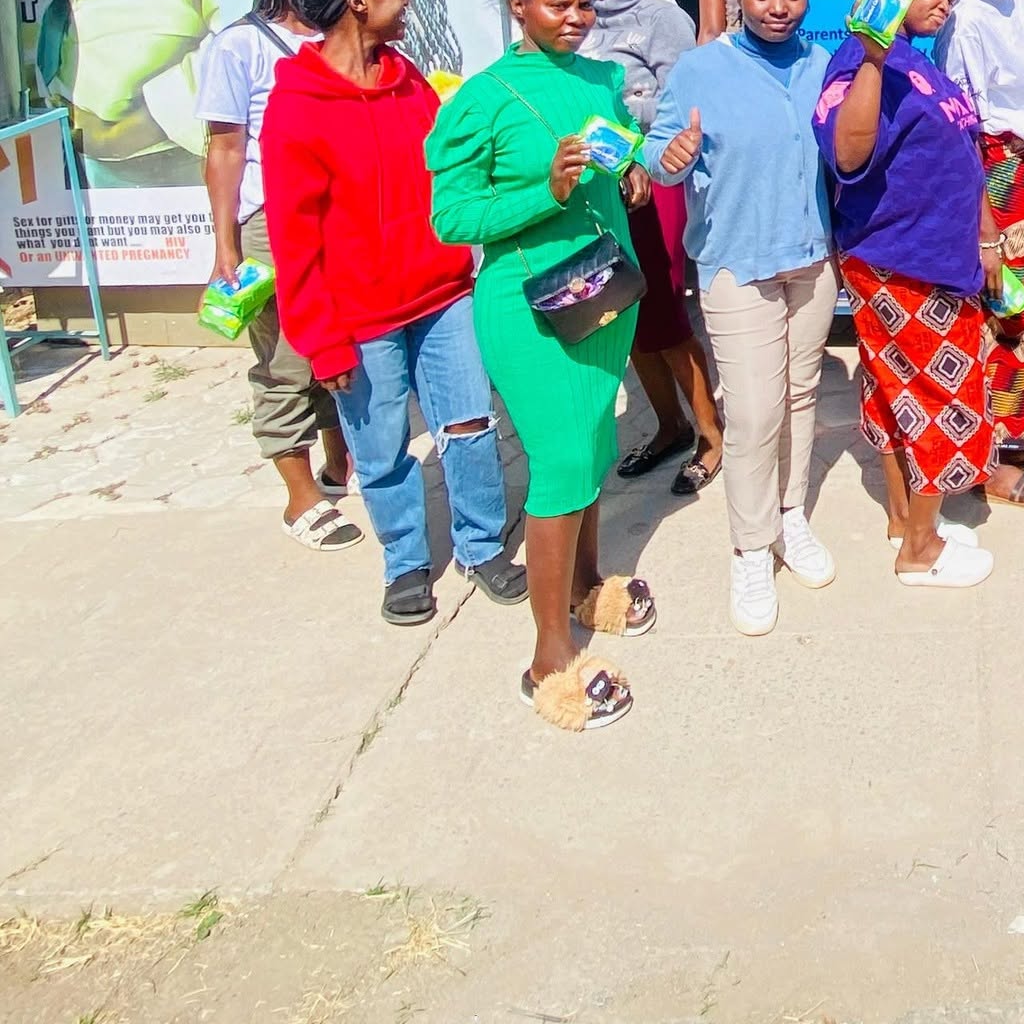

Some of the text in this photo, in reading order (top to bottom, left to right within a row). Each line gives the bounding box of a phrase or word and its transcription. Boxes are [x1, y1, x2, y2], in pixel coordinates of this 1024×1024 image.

[799, 29, 850, 42] Parents
[13, 216, 34, 227] Sex
[85, 214, 95, 225] or
[99, 214, 135, 226] money
[138, 213, 161, 225] may
[164, 214, 182, 224] get
[185, 213, 206, 224] you
[15, 226, 52, 239] things
[55, 226, 75, 238] you
[107, 225, 126, 236] but
[128, 224, 148, 236] you
[150, 224, 174, 235] may
[177, 223, 201, 234] also
[16, 237, 45, 249] what
[50, 238, 75, 249] you
[102, 236, 128, 247] want
[165, 237, 186, 247] HIV
[19, 252, 33, 263] Or
[37, 252, 50, 262] an
[122, 248, 190, 261] PREGNANCY
